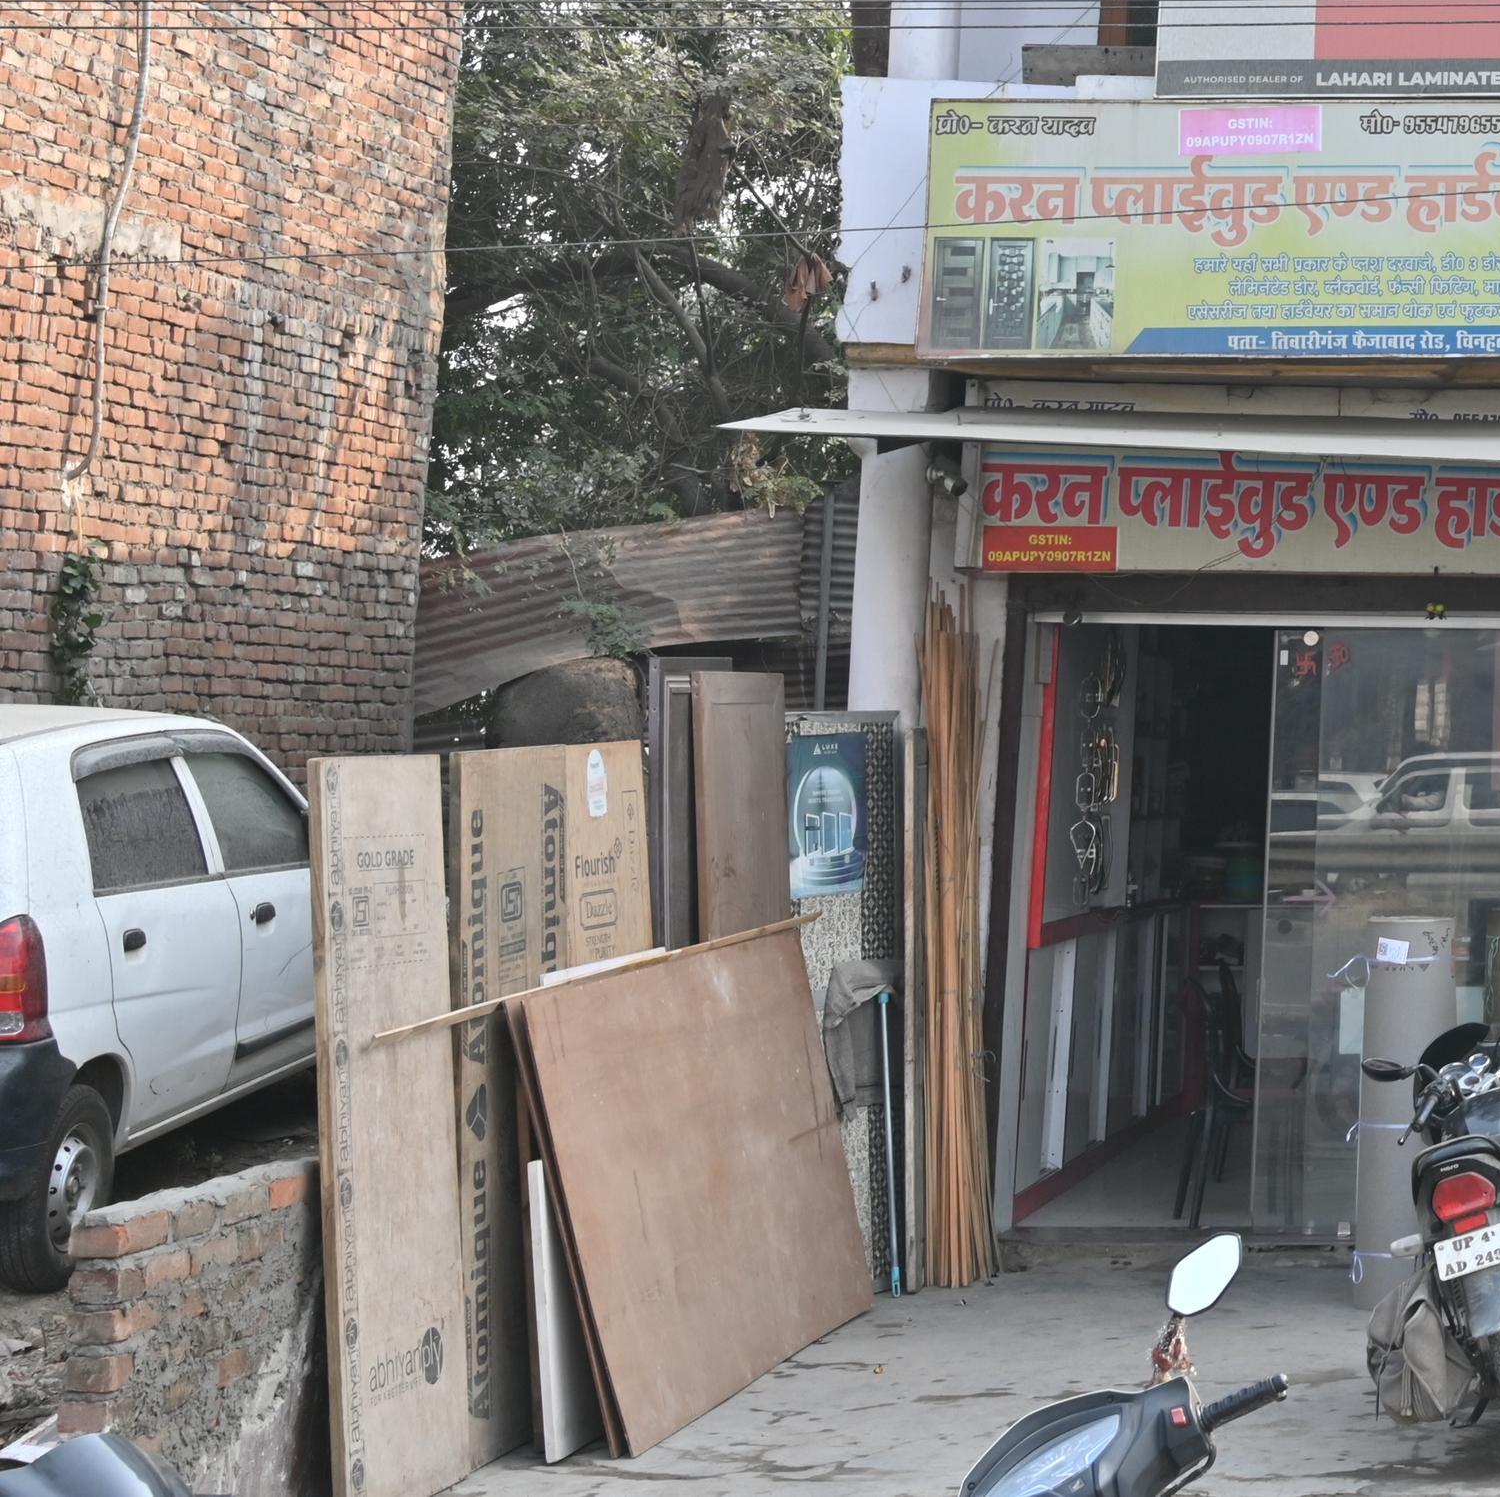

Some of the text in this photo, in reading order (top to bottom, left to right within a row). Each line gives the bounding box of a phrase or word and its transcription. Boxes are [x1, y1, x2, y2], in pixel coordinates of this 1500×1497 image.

[1184, 75, 1244, 85] AUTHORISED
[1247, 75, 1286, 84] DEALER
[1290, 74, 1304, 83] OF
[1316, 72, 1392, 87] LAHARI
[954, 175, 1081, 225] करन
[1091, 155, 1283, 247] प्लाईवुड
[1293, 175, 1395, 237] एण्ड
[982, 463, 1107, 525] करन
[1119, 451, 1310, 557] प्लाईवुड
[1322, 474, 1427, 548] एण्ड
[357, 850, 414, 868] GOLD GRADE
[472, 1158, 493, 1420] Atomique
